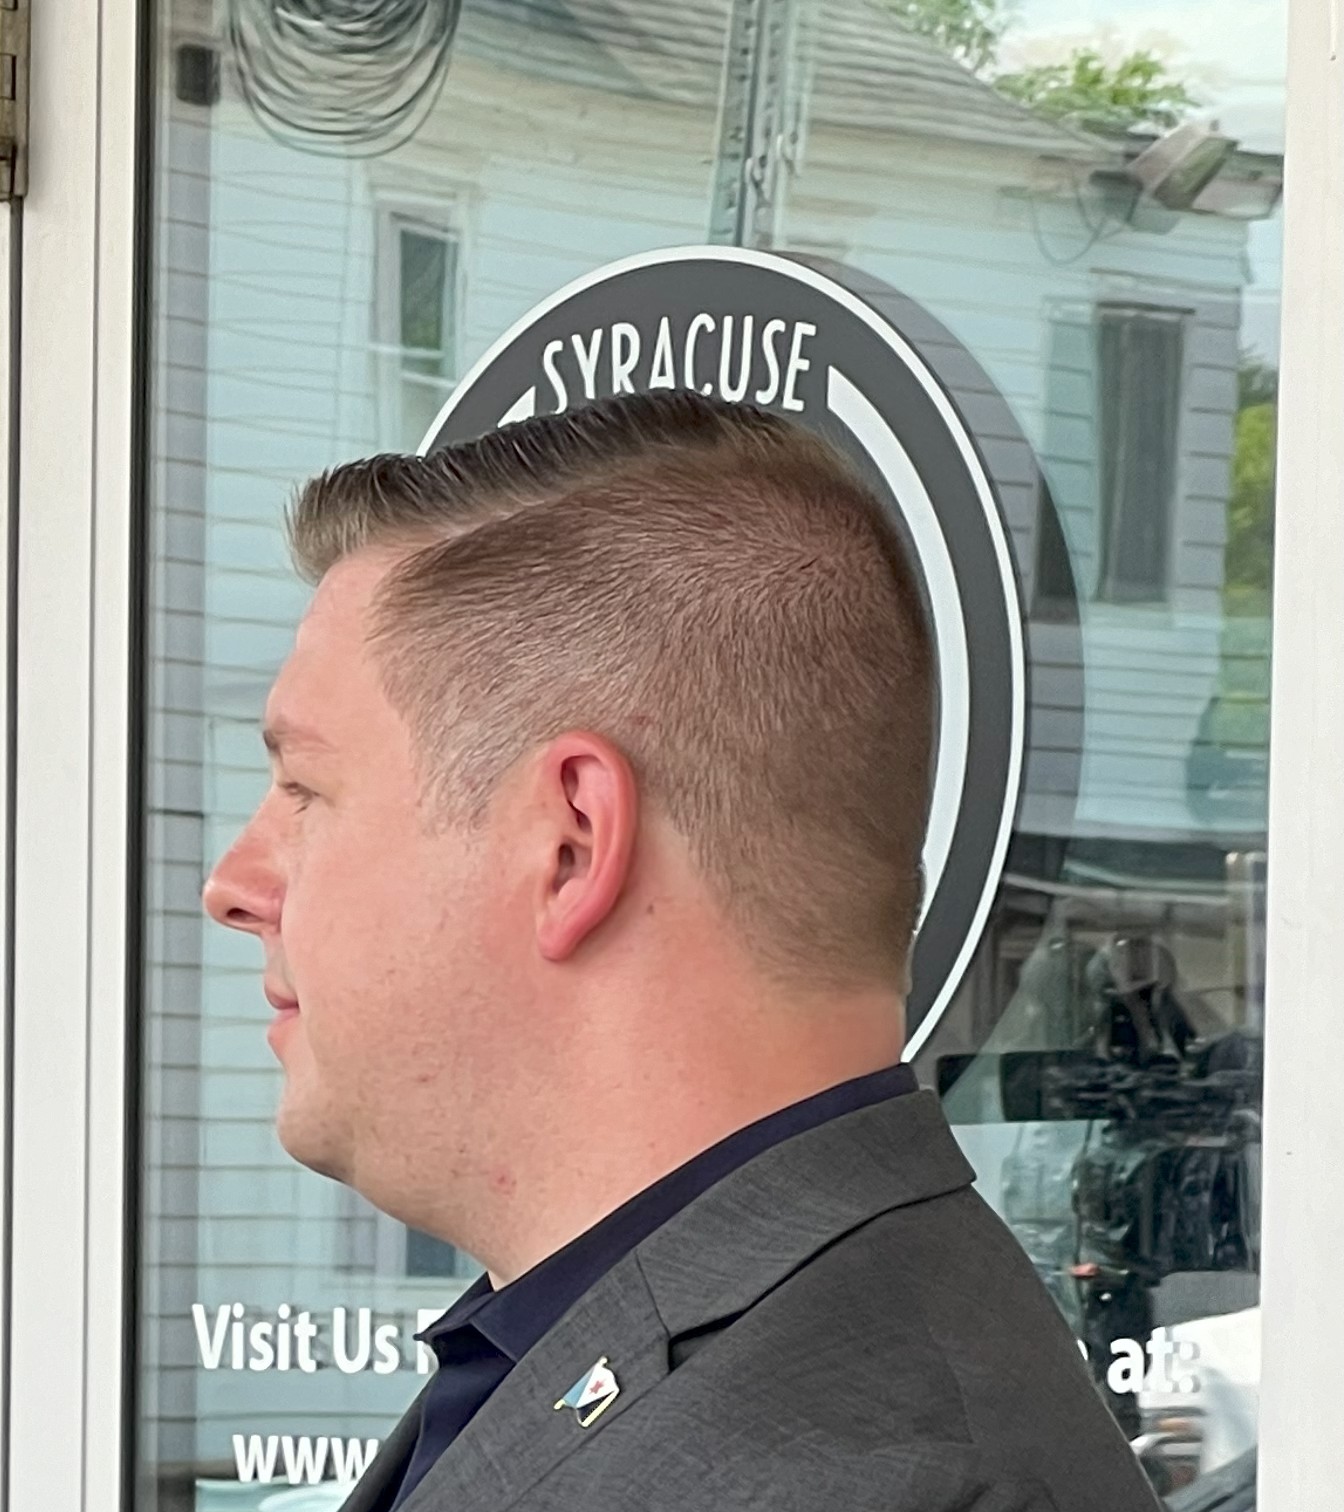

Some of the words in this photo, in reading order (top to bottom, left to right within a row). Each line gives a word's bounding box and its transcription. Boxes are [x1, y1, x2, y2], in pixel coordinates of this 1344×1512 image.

[542, 313, 817, 414] SYRACUSE
[192, 1302, 317, 1373] Visit
[333, 1307, 399, 1375] Us
[1108, 1327, 1196, 1394] at:
